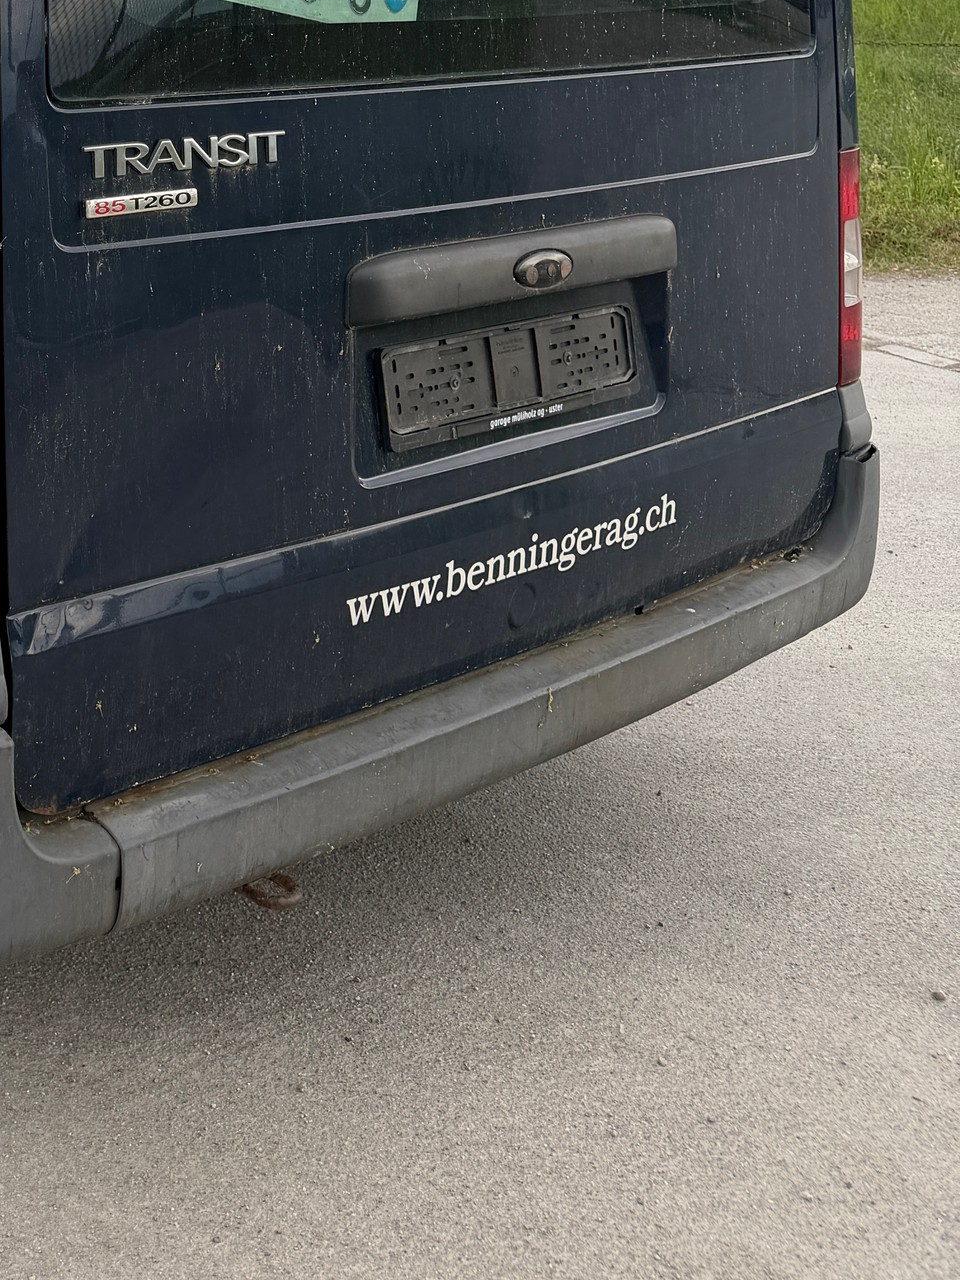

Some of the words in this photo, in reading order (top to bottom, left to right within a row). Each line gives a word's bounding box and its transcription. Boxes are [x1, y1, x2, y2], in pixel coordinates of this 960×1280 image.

[81, 130, 286, 180] TRANSIT
[489, 416, 511, 429] garage
[536, 408, 545, 418] ag
[548, 403, 563, 414] uster
[346, 493, 678, 626] www.benningerag.ch
